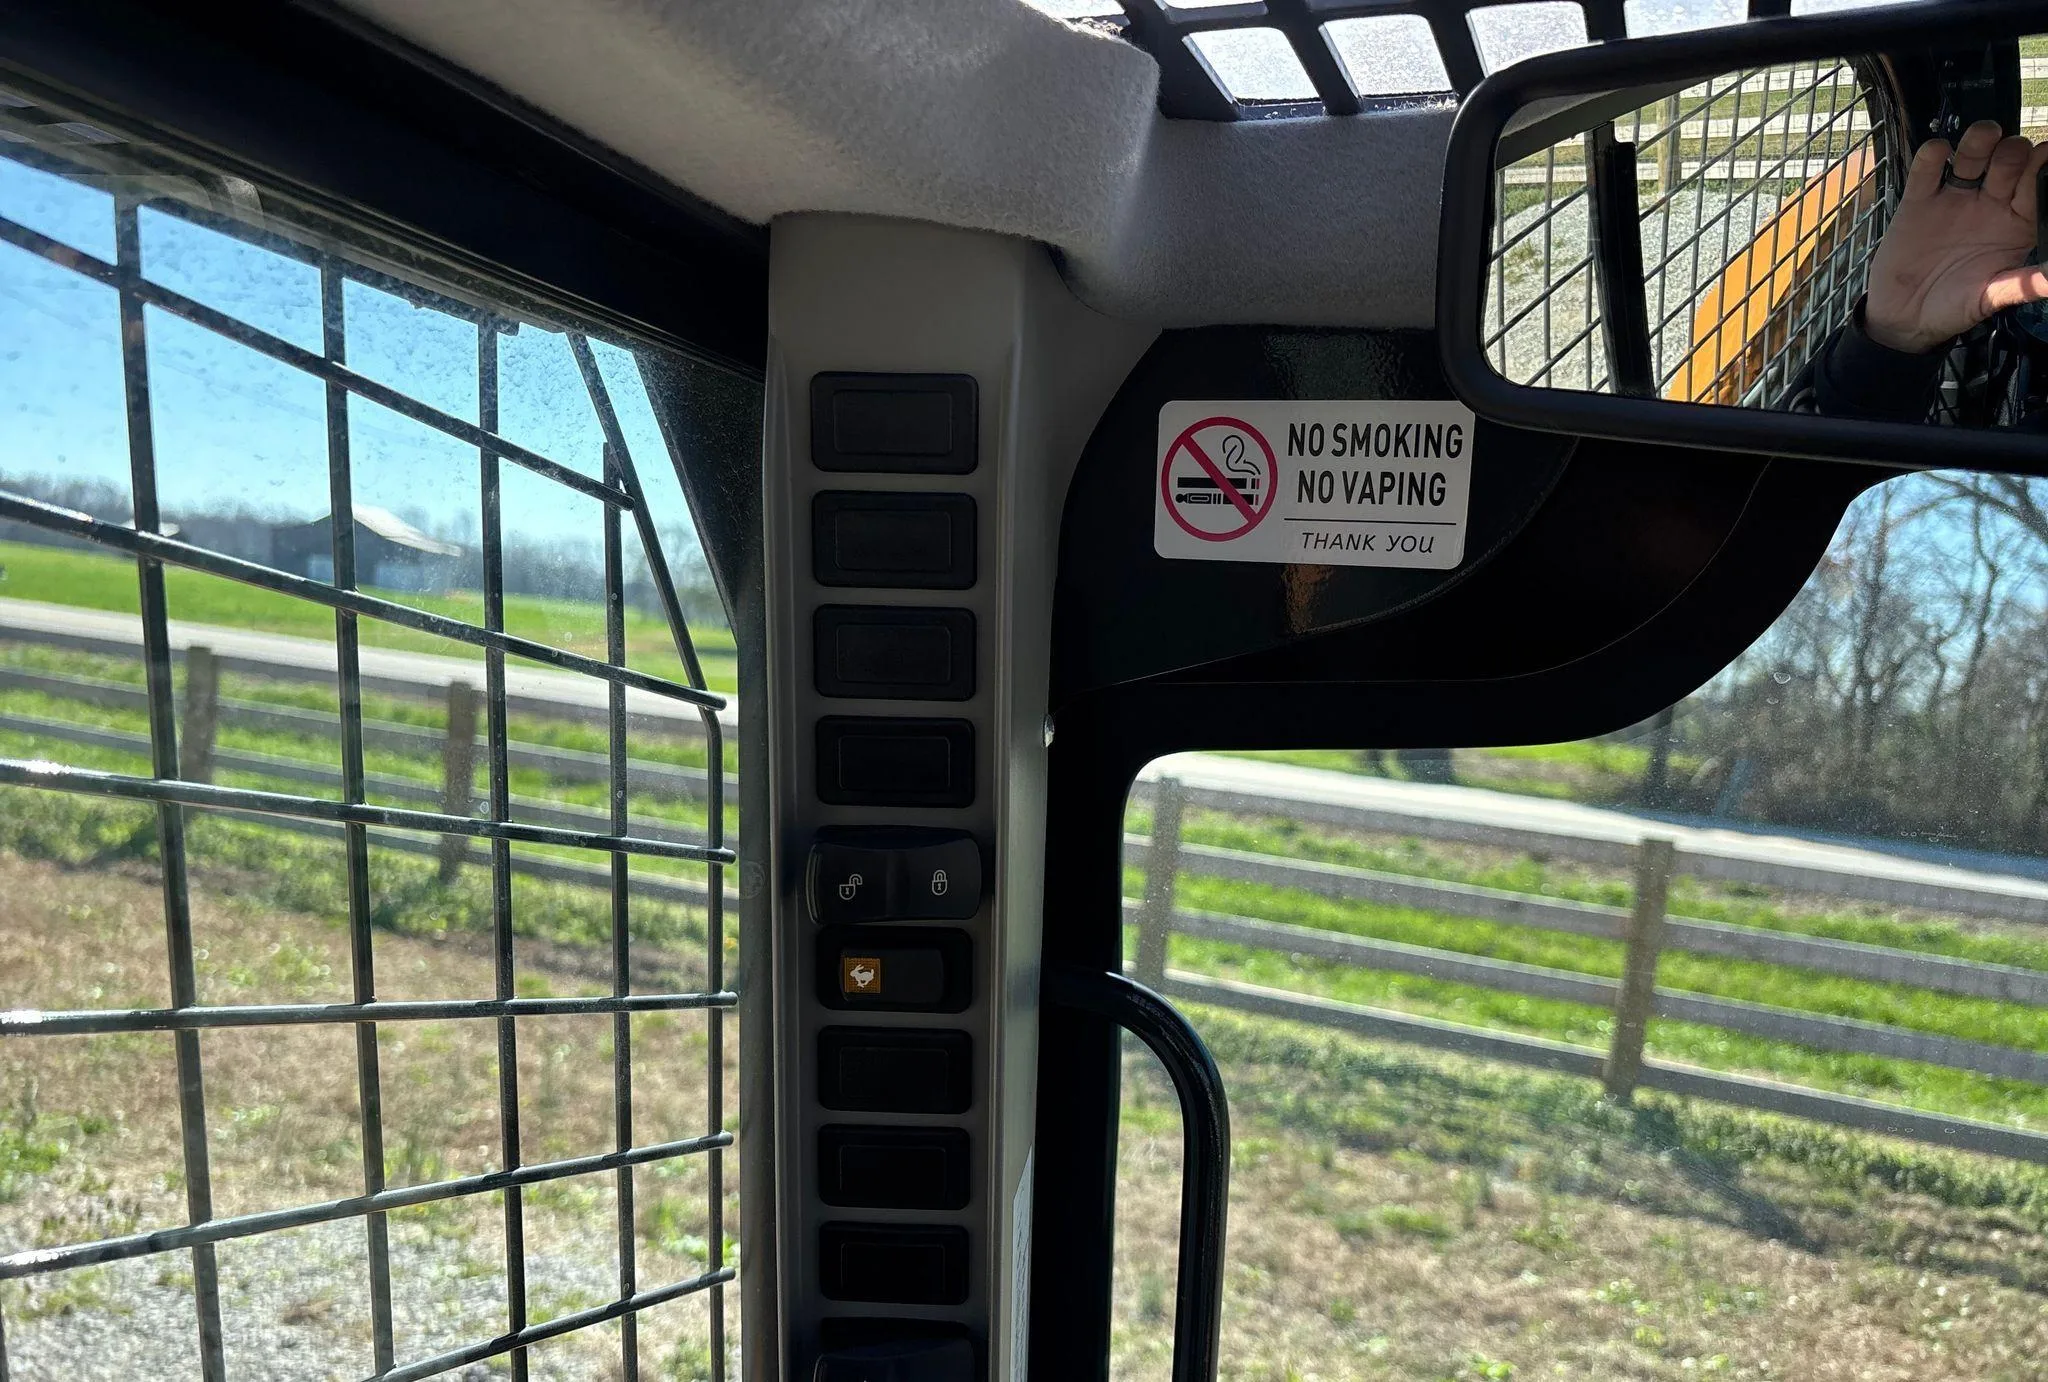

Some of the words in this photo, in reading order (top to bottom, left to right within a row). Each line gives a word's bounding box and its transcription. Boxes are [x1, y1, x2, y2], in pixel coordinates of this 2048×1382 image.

[1287, 422, 1325, 457] NO
[1331, 422, 1464, 459] SMOKING
[1297, 470, 1334, 504] NO
[1342, 470, 1447, 507] VAPING
[1301, 532, 1376, 552] THANK
[1385, 534, 1435, 554] YOU
